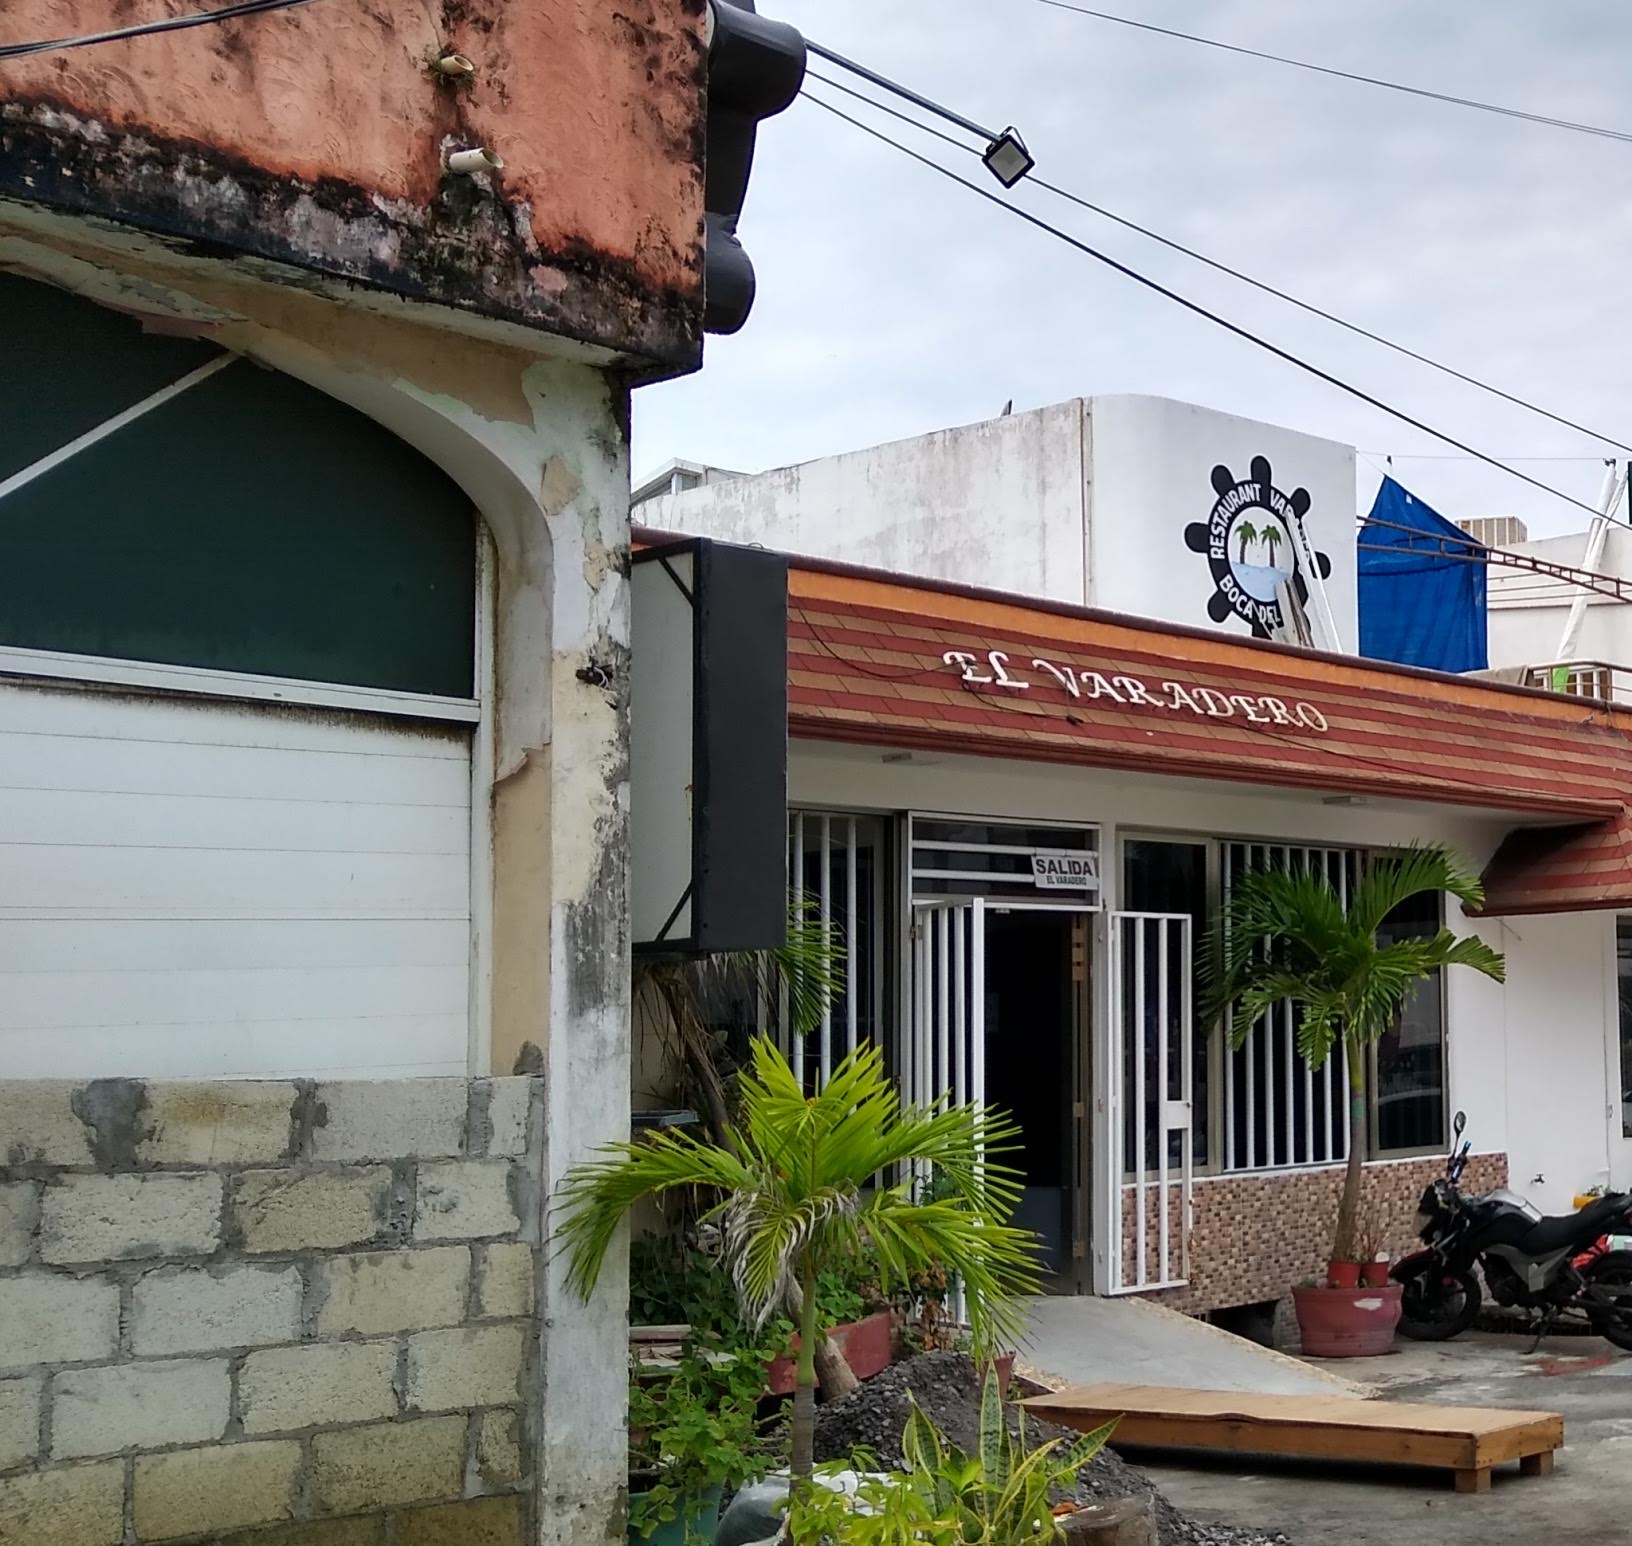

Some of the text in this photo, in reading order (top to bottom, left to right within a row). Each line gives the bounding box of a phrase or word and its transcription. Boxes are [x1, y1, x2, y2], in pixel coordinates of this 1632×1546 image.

[1210, 483, 1261, 559] RESTAURANT
[1219, 573, 1281, 624] BOCA DEL
[943, 650, 1328, 732] EL VARADERO
[1035, 859, 1093, 876] SALIDA
[1046, 875, 1055, 884] EL
